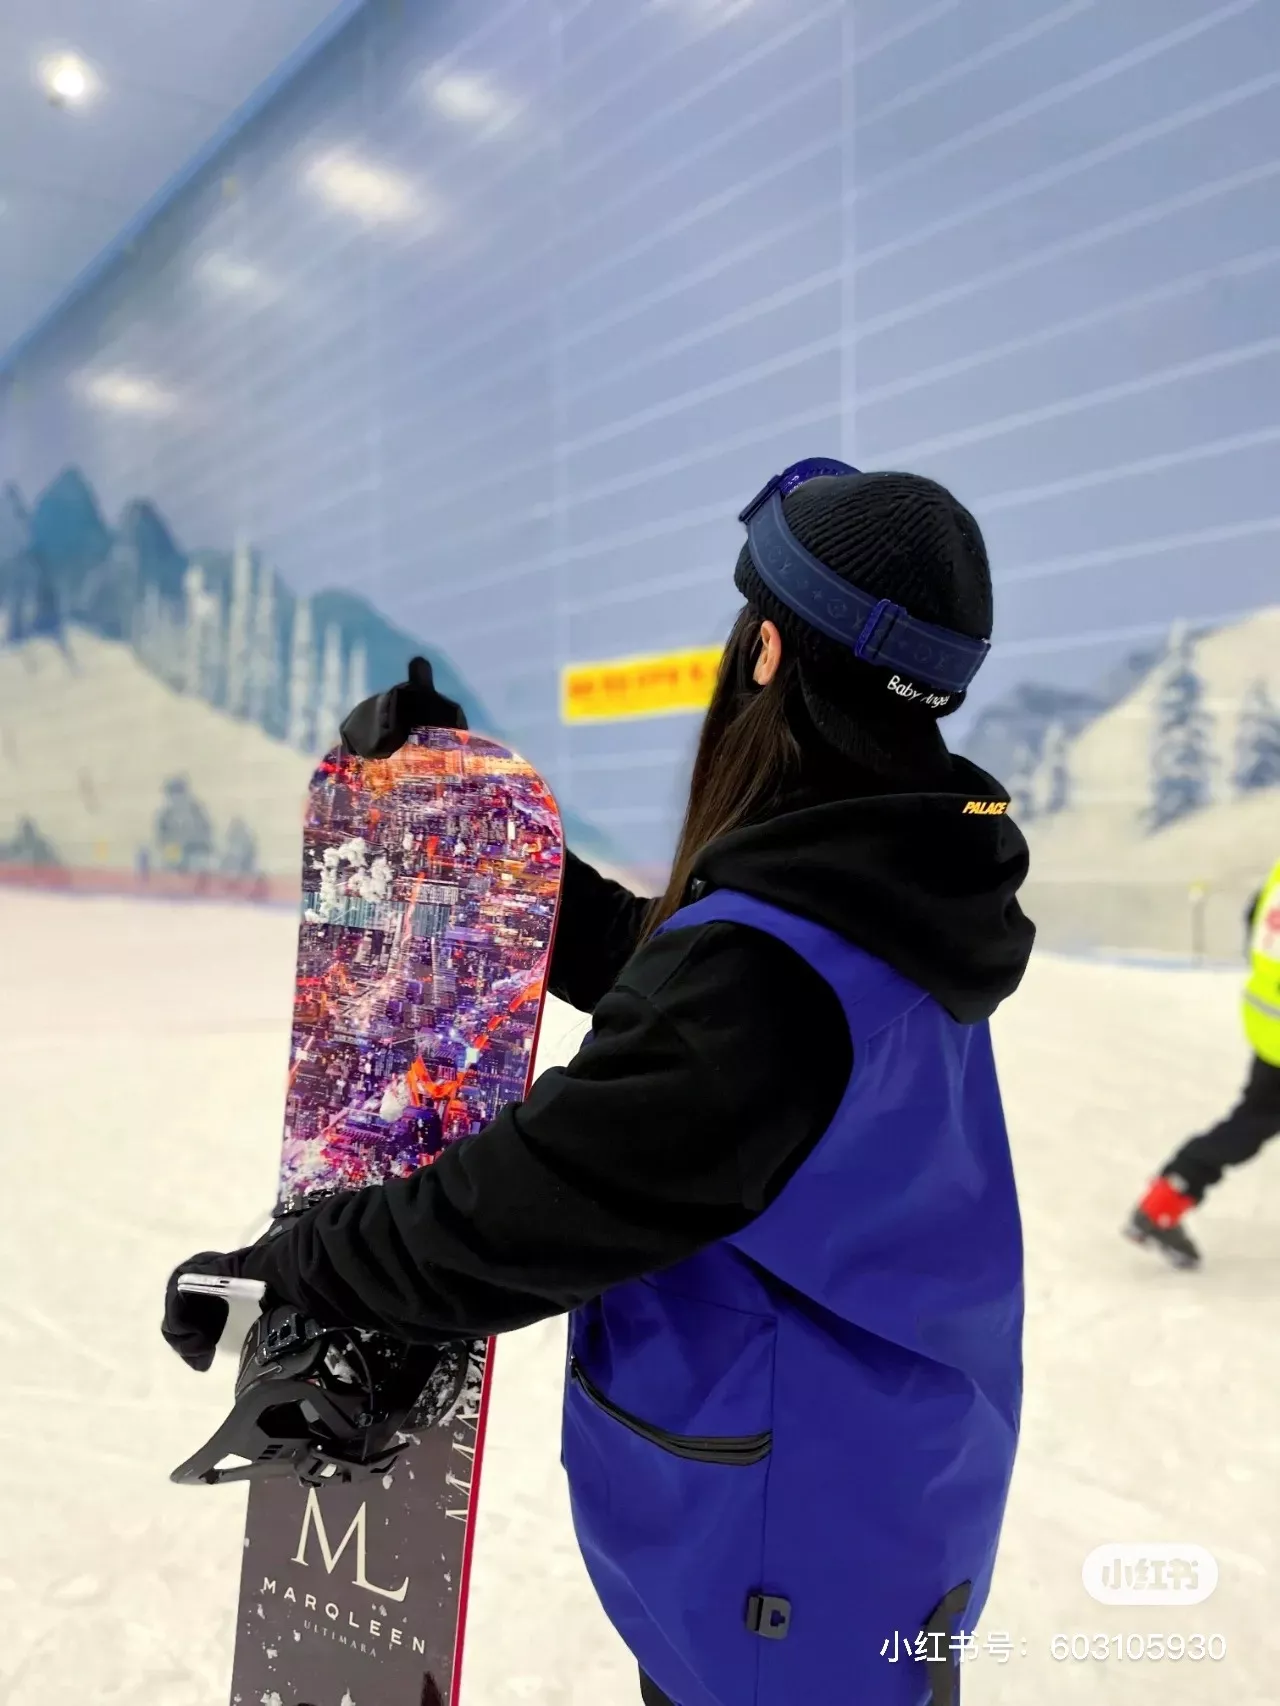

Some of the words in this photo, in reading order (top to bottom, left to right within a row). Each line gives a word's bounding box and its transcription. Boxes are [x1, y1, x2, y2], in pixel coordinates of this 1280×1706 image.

[887, 675, 922, 700] Baby
[962, 801, 1007, 815] PALACE
[263, 1577, 426, 1654] MARQLEEN
[303, 1620, 377, 1657] ULTIMARA
